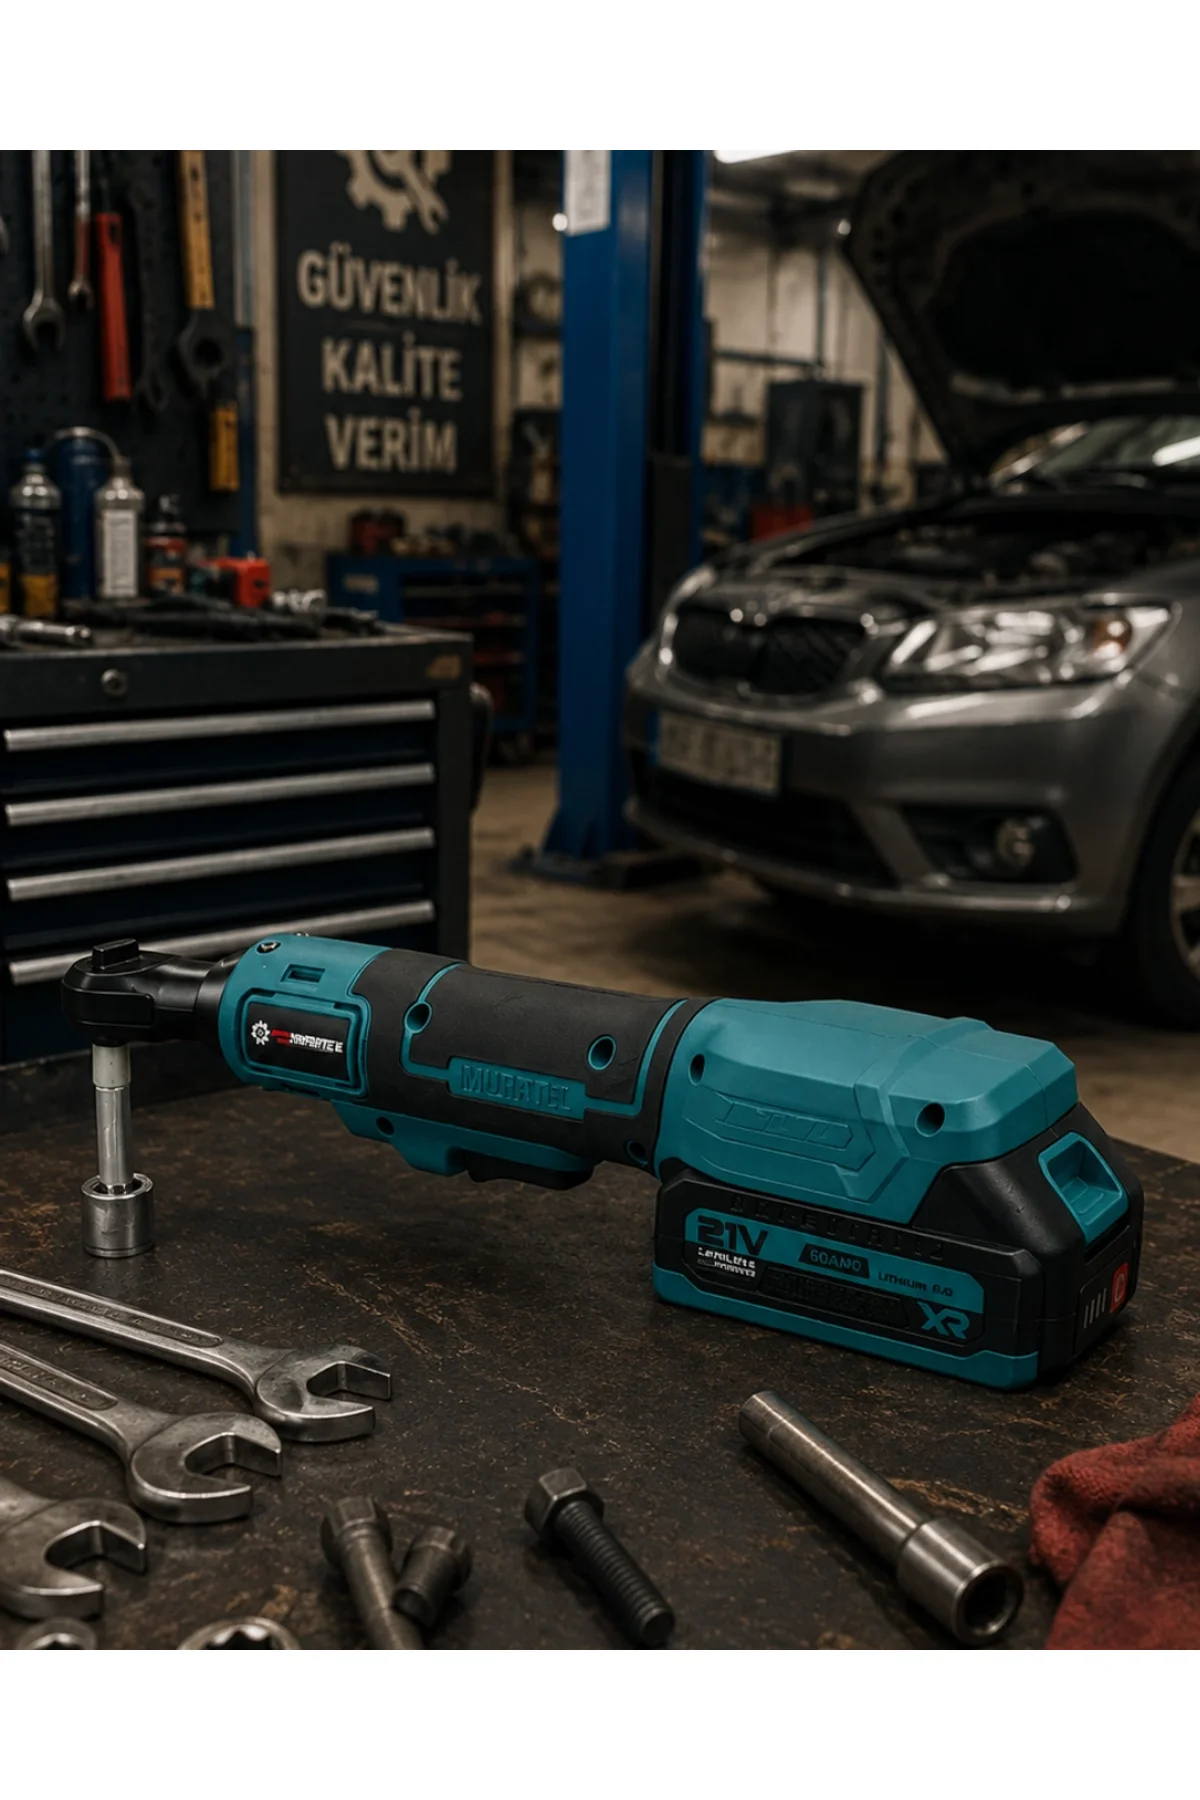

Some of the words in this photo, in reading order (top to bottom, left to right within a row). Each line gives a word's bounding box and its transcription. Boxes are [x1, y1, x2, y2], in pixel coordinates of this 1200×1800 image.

[297, 241, 481, 324] GÜVENLİK
[321, 331, 462, 400] KALİTE
[324, 406, 457, 474] VERİM
[697, 1214, 769, 1257] 21V
[916, 1300, 971, 1341] XR
